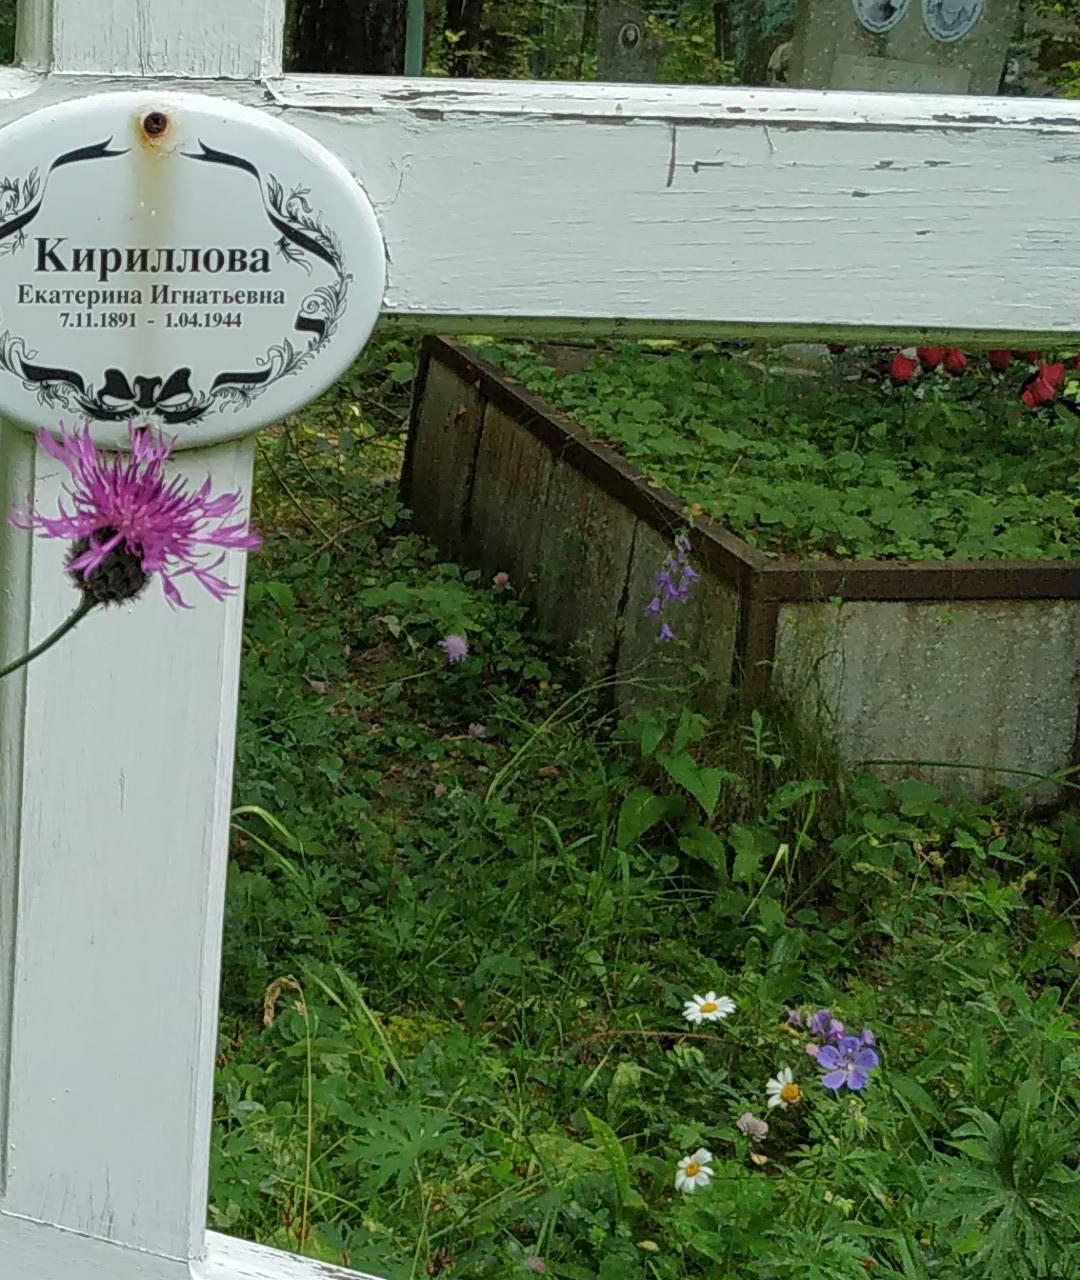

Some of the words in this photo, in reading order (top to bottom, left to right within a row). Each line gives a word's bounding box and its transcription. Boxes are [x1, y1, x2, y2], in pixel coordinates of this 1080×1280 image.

[34, 237, 272, 282] Кириллова
[17, 284, 143, 309] Екатерина
[150, 284, 286, 305] Игнатьевна
[59, 312, 137, 329] 7.11.1891
[165, 312, 242, 329] 1.04.1944
